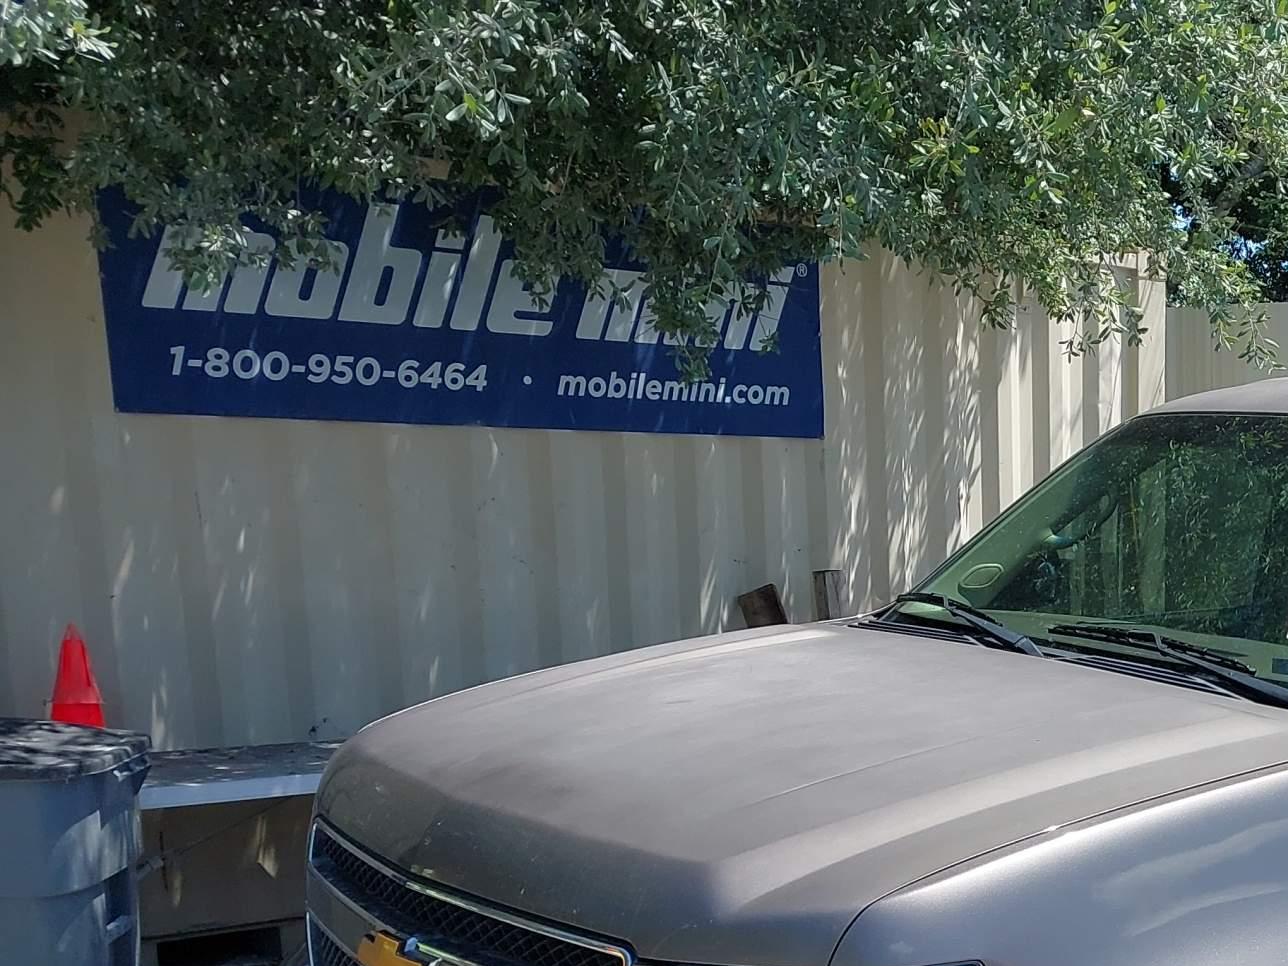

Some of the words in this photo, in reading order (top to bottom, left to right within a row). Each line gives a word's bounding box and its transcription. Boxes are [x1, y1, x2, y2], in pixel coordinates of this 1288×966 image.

[141, 203, 559, 337] mobile
[169, 346, 488, 391] 1-800-950-6464
[557, 371, 790, 406] mobilemini.com
